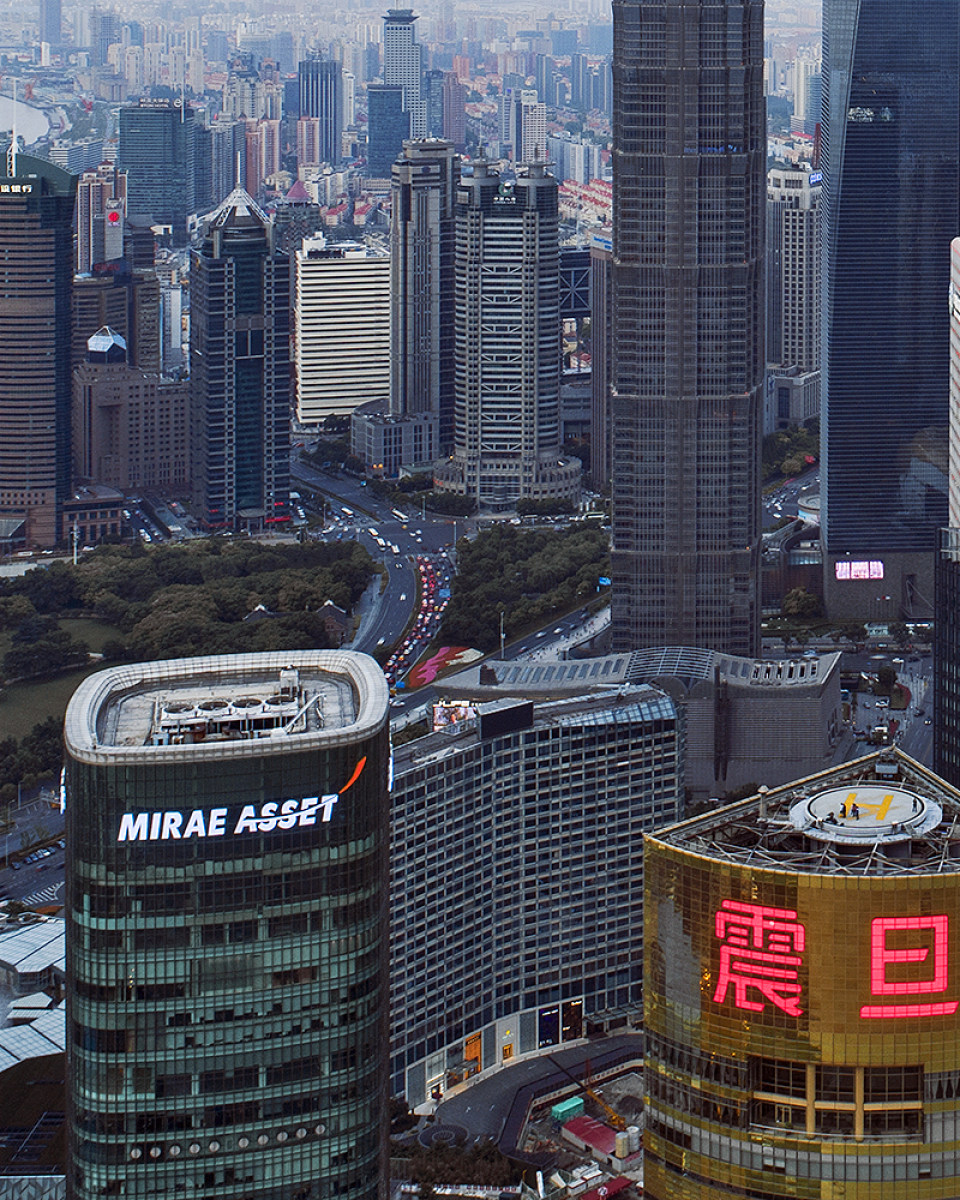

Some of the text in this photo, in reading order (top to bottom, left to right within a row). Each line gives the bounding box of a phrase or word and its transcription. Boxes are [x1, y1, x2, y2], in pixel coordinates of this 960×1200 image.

[117, 794, 339, 842] MIRAE ASSET
[713, 899, 960, 1020] 震旦
